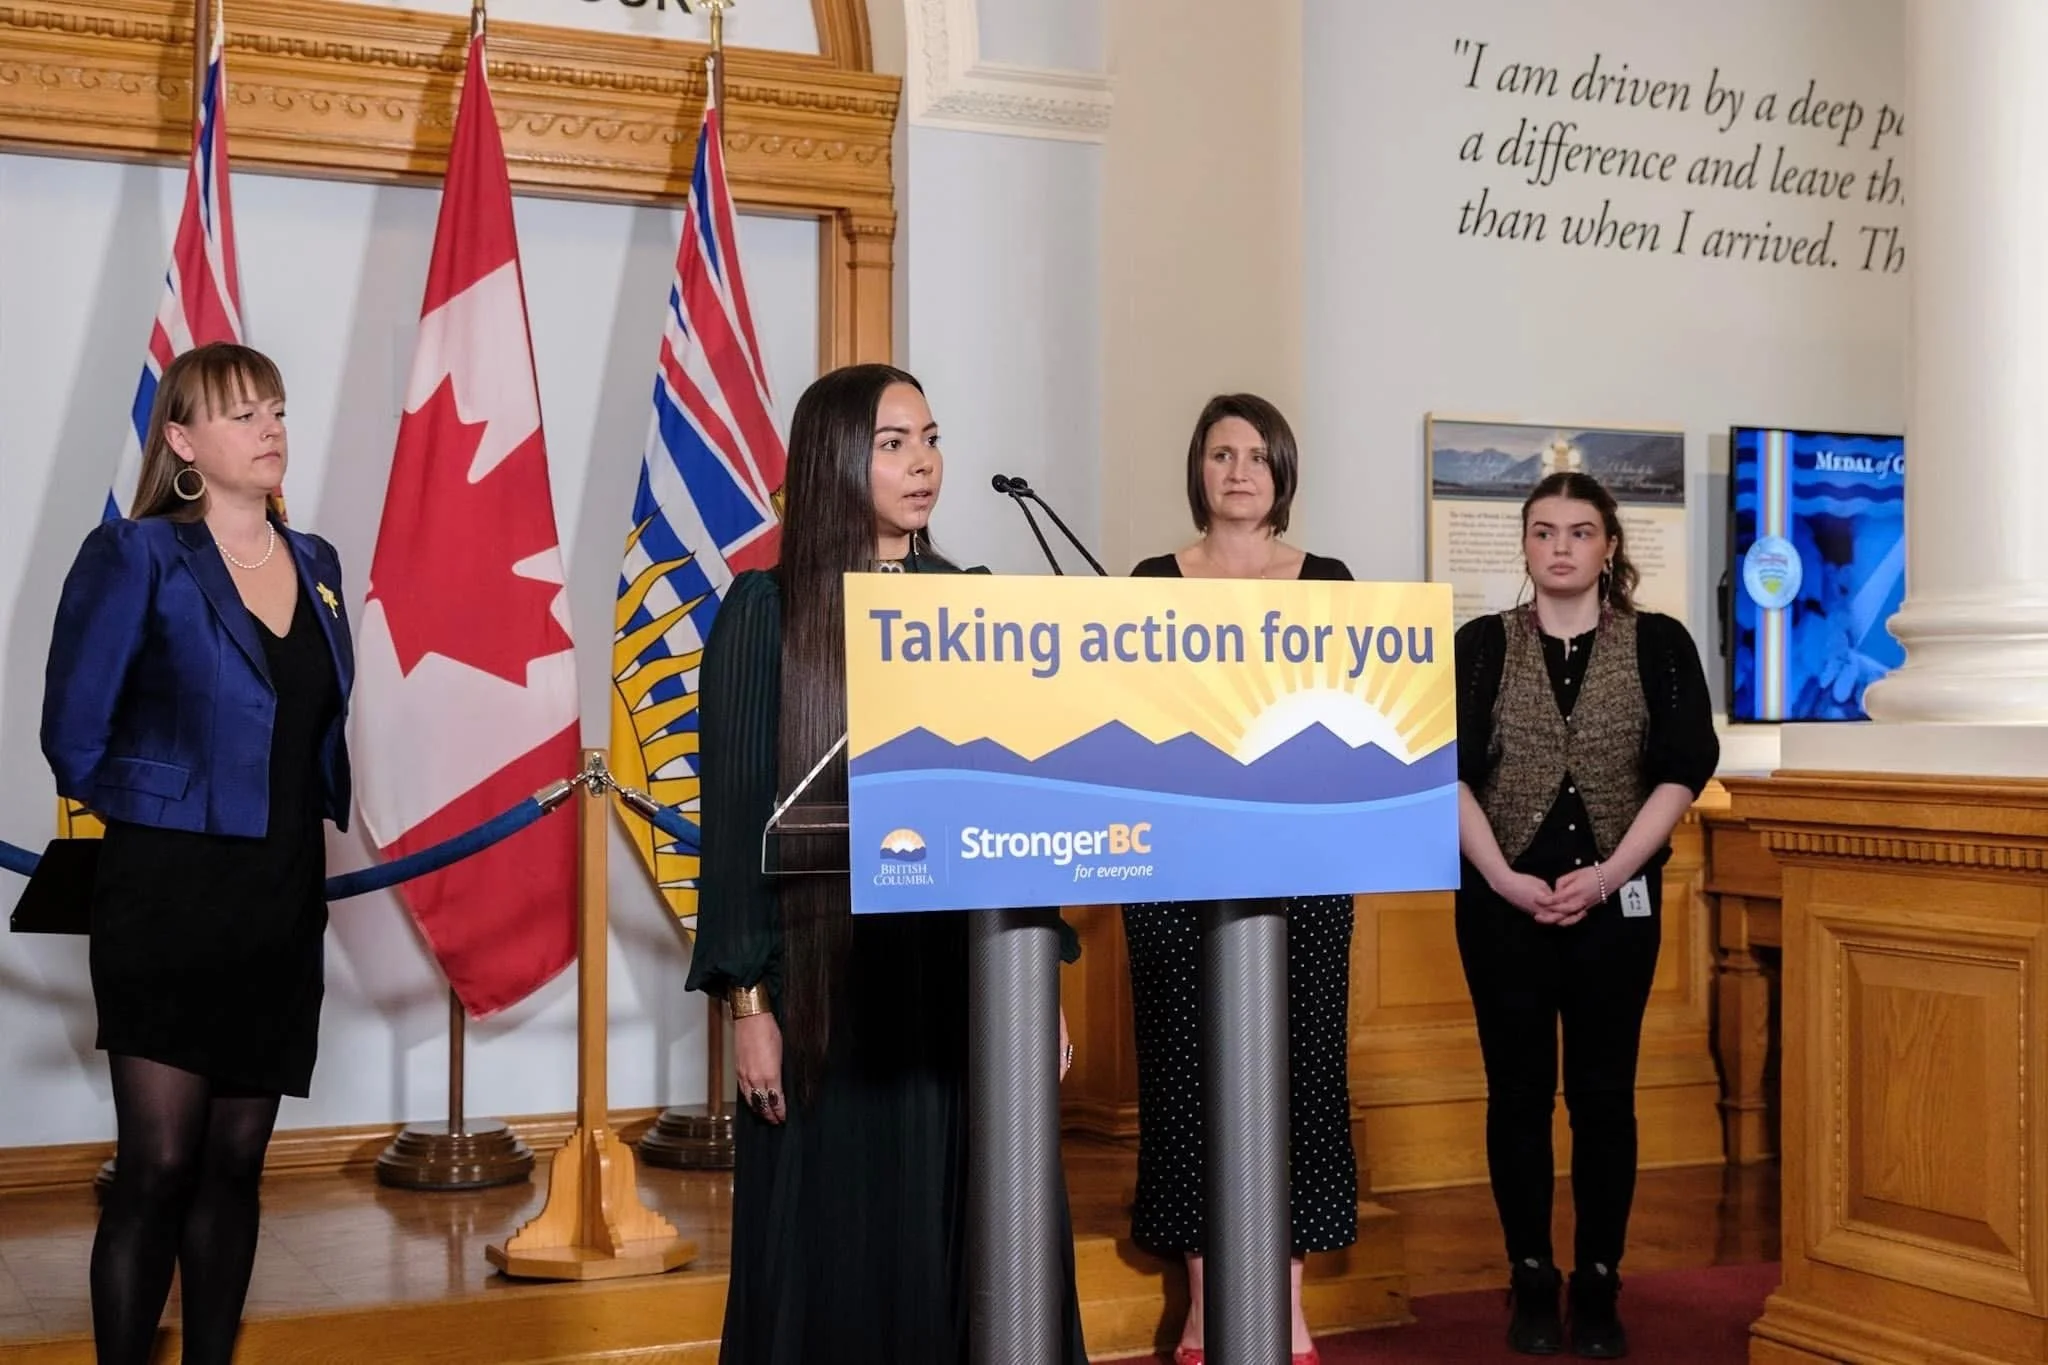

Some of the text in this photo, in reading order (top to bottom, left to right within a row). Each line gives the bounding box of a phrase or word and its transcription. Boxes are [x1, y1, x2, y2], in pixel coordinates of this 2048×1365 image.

[1453, 37, 1489, 90] "I
[1495, 62, 1559, 98] am
[1570, 52, 1691, 113] driven
[1703, 66, 1745, 134] by
[1754, 93, 1778, 123] a
[1787, 78, 1865, 148] deep
[1458, 116, 1905, 206] a difference and leave th
[1457, 186, 1547, 243] than
[1561, 198, 1661, 253] when
[1671, 209, 1695, 255] I
[1701, 219, 1838, 269] arrived.
[1815, 450, 1875, 473] MEDAL
[1875, 452, 1896, 480] of
[869, 607, 1434, 679] Taking action for you
[960, 821, 1152, 867] StrongerBC
[873, 873, 935, 886] COLUMBIA
[880, 863, 928, 875] BRITISH
[1073, 863, 1153, 882] for everyone
